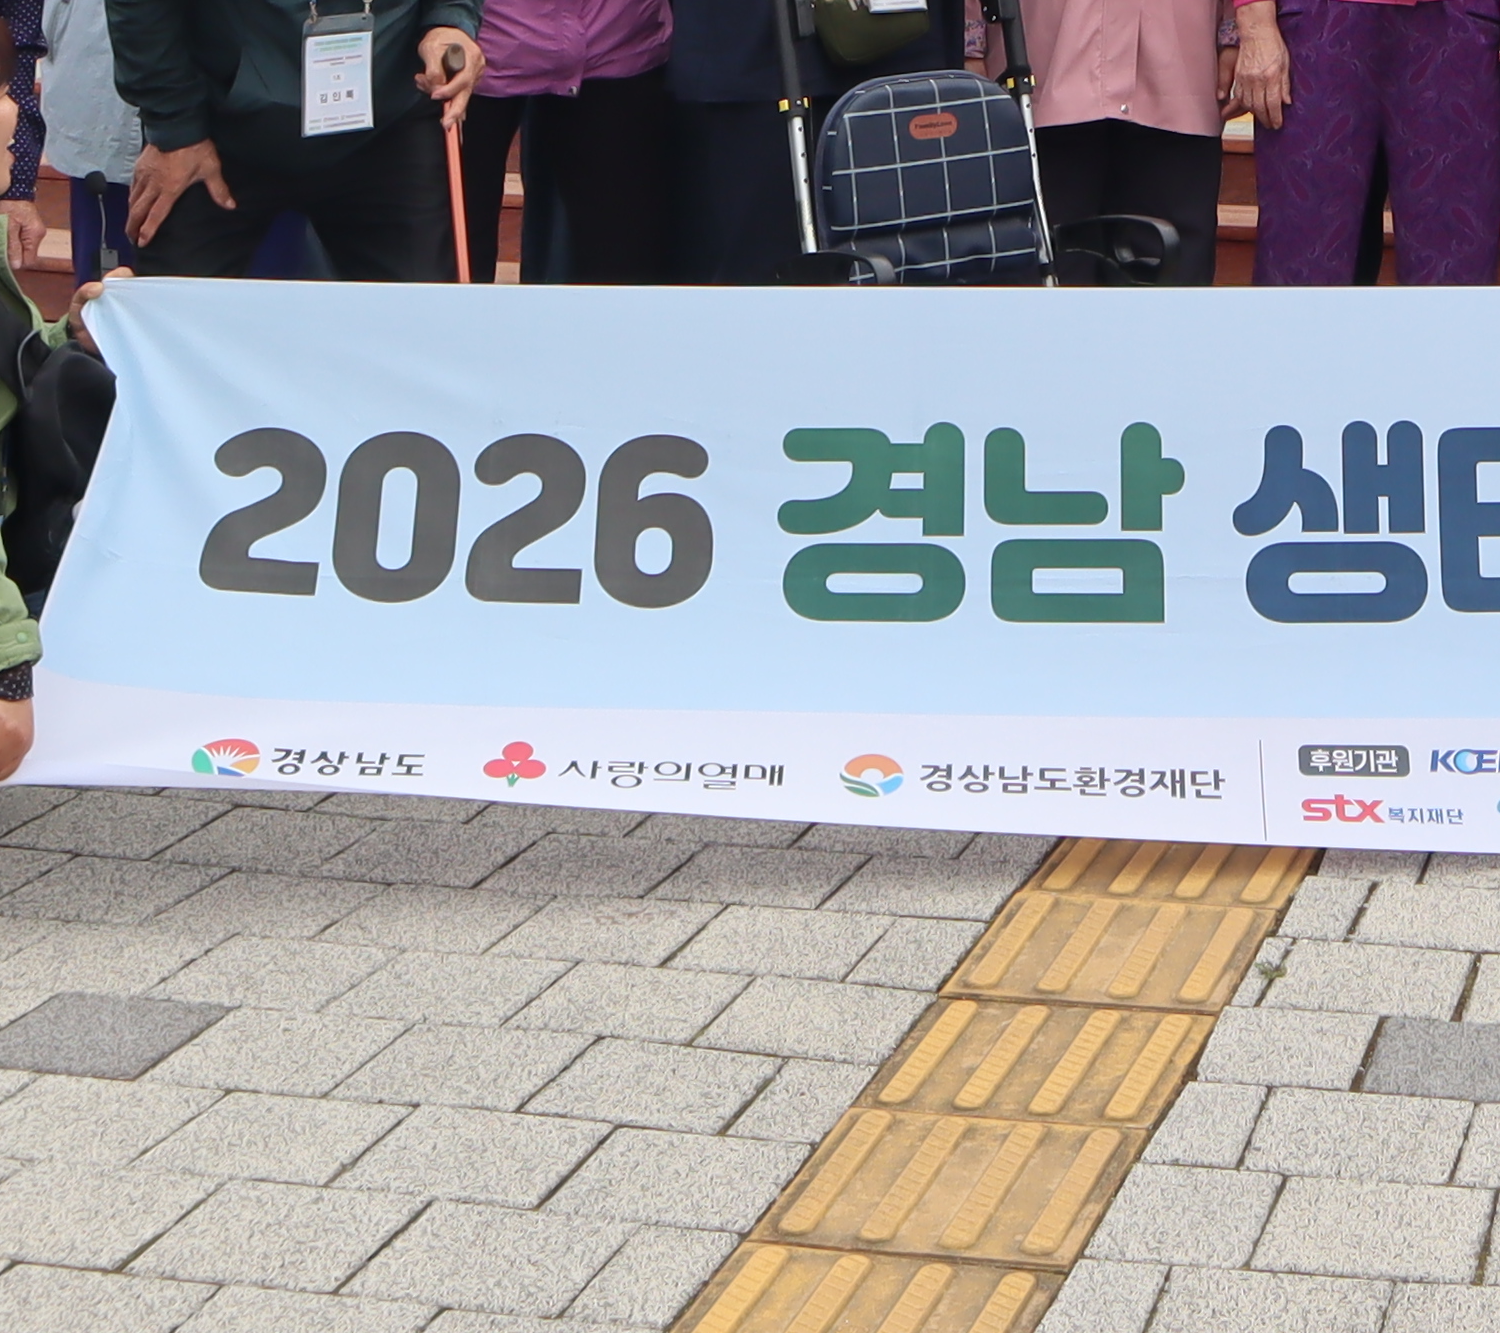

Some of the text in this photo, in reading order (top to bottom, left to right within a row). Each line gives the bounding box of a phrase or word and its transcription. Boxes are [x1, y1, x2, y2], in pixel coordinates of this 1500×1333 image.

[197, 425, 714, 610] 2026
[776, 421, 1186, 624] 경남
[270, 748, 426, 777] 경상남도
[557, 758, 786, 790] 사랑의열매
[1309, 748, 1399, 773] 후원기관
[919, 763, 1226, 801] 경상남도환경재단
[1301, 794, 1464, 825] stx 복지재단
